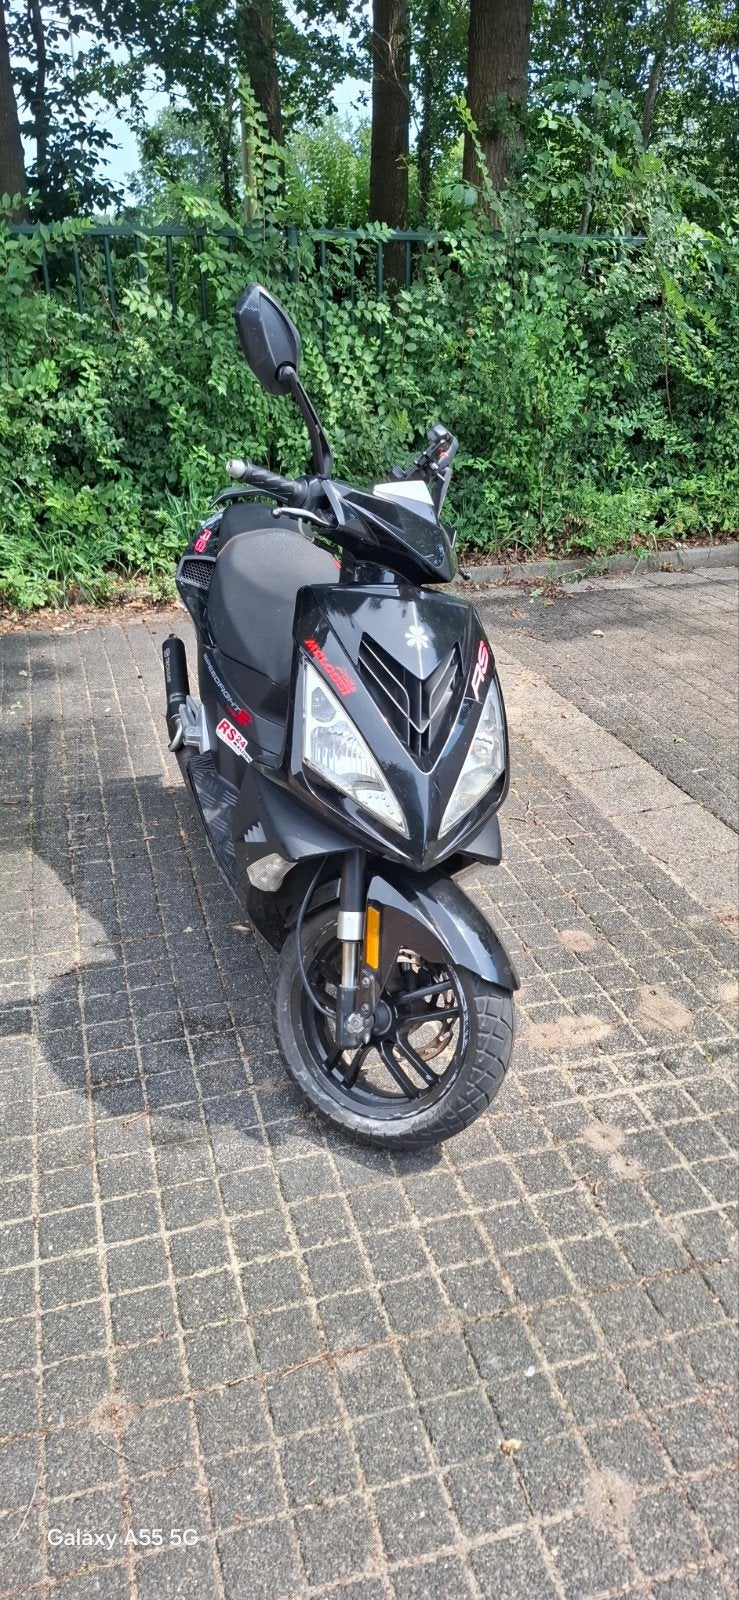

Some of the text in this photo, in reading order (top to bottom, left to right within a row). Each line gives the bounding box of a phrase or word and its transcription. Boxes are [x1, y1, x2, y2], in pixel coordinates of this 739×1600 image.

[203, 653, 241, 711] SPEEDFIGHT
[304, 639, 350, 696] MALOSSI
[471, 640, 489, 701] RS
